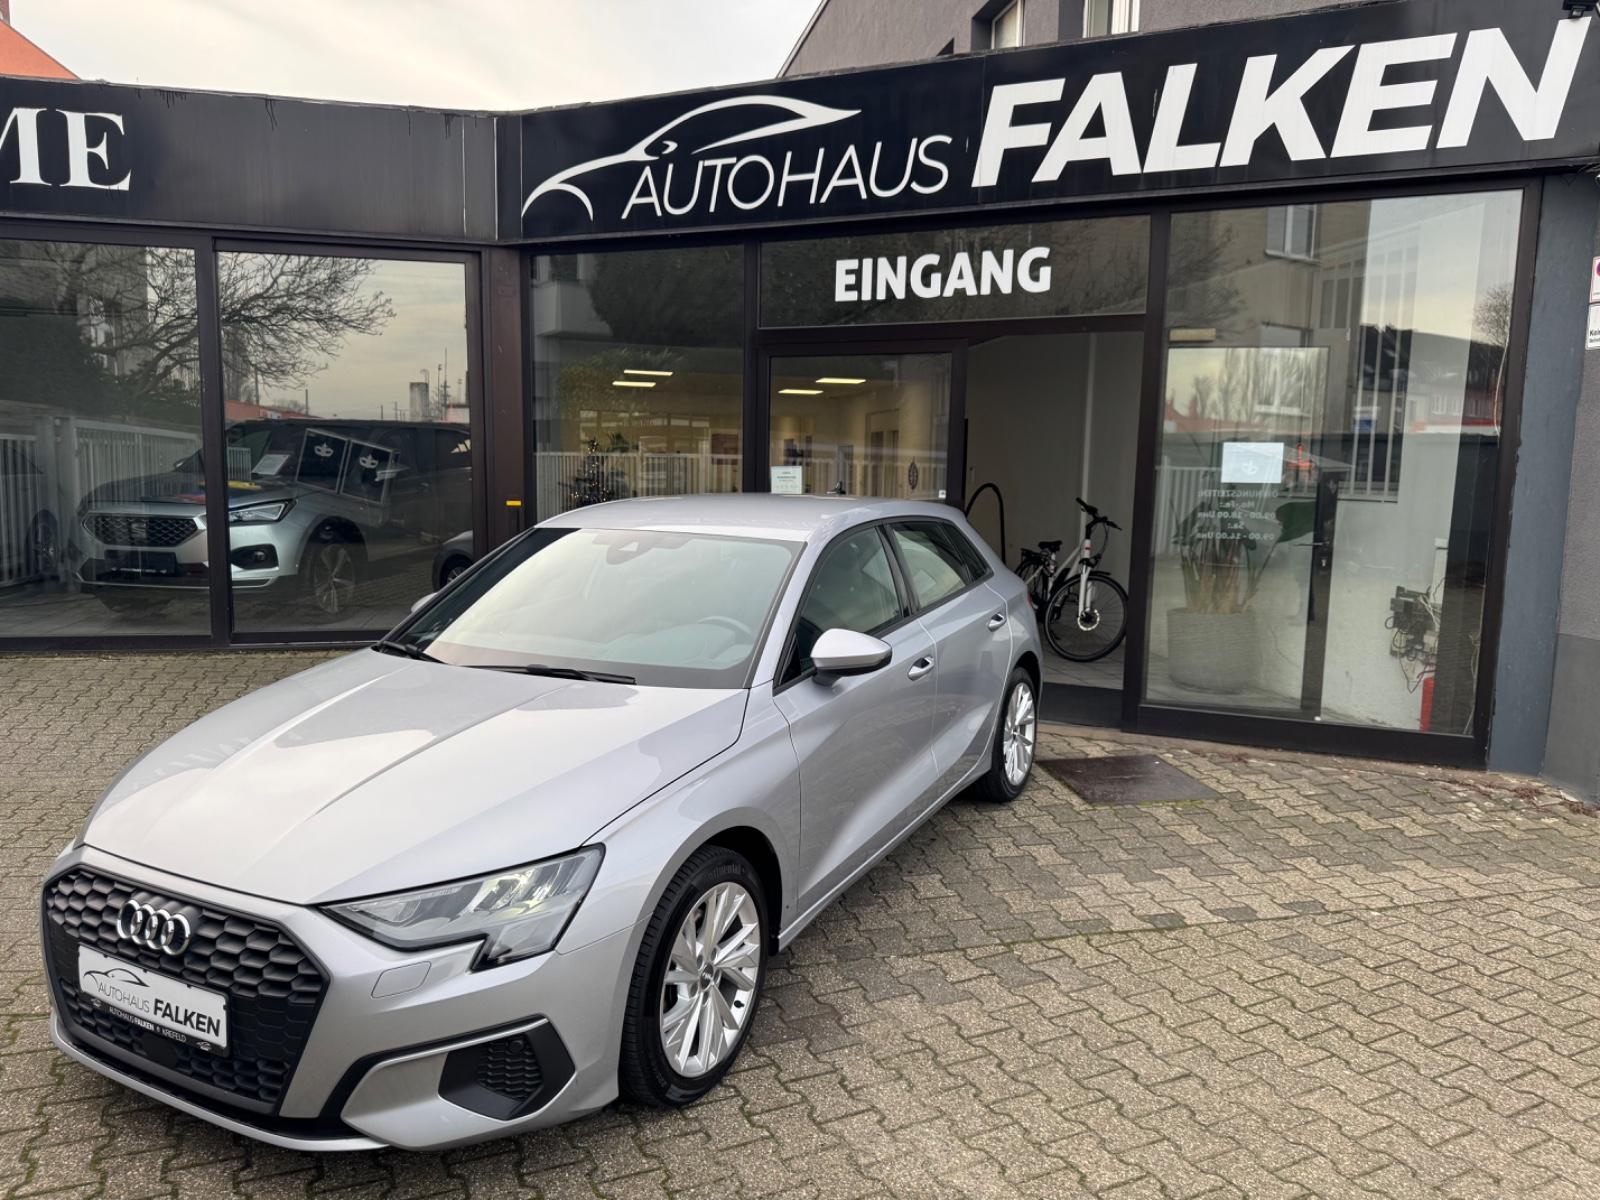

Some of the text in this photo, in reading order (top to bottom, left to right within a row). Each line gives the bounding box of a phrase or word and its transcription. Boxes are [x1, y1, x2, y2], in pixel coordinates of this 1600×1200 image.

[621, 16, 1591, 220] AUTOHAUS FALKEN
[834, 246, 1052, 304] EINGANG
[98, 982, 221, 1037] AUTOHAUS FALKEN
[134, 1017, 155, 1032] FALKEN
